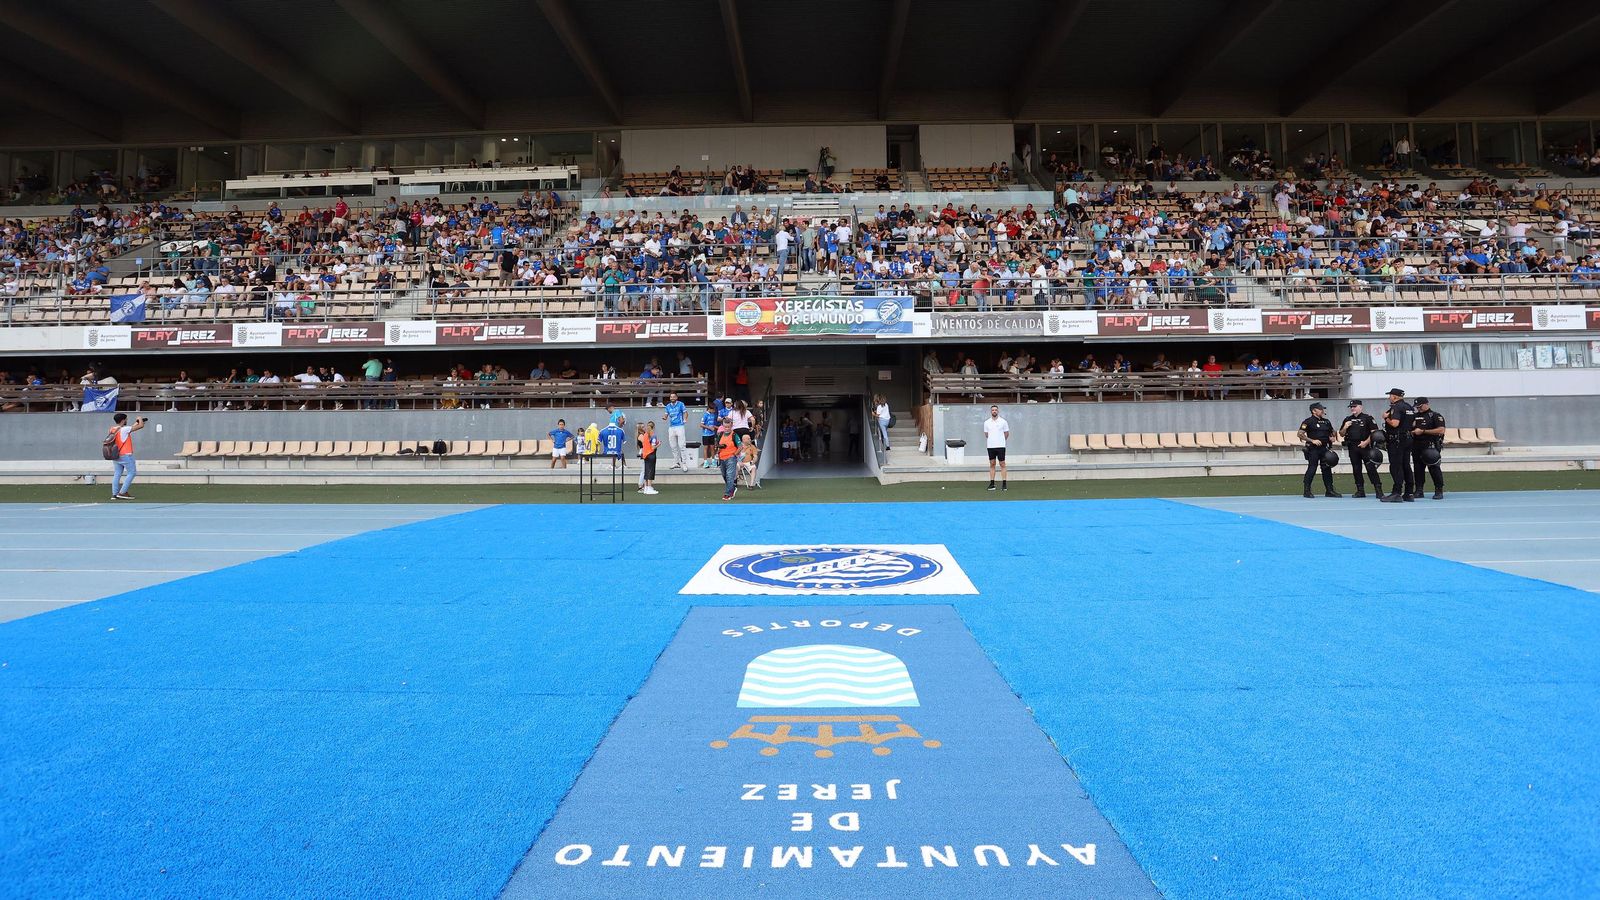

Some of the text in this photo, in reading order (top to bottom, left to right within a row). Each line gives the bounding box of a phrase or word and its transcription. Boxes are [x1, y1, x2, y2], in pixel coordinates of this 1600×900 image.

[774, 299, 864, 313] XERECISTAS
[774, 313, 864, 325] POR EL MUNDO
[988, 319, 1000, 329] DE
[1105, 316, 1144, 326] PLAY
[1269, 315, 1308, 325] PLAY
[1430, 314, 1468, 324] PLAY
[288, 329, 324, 338] PLAY
[442, 325, 480, 337] PLAY
[602, 323, 640, 334] PLAY
[137, 331, 174, 341] PLAY
[607, 434, 617, 449] 30
[721, 619, 922, 638] DEPORTES
[740, 778, 902, 801] JEREZ
[789, 810, 860, 832] DE
[553, 842, 1099, 869] AYUNTAMIENTO
